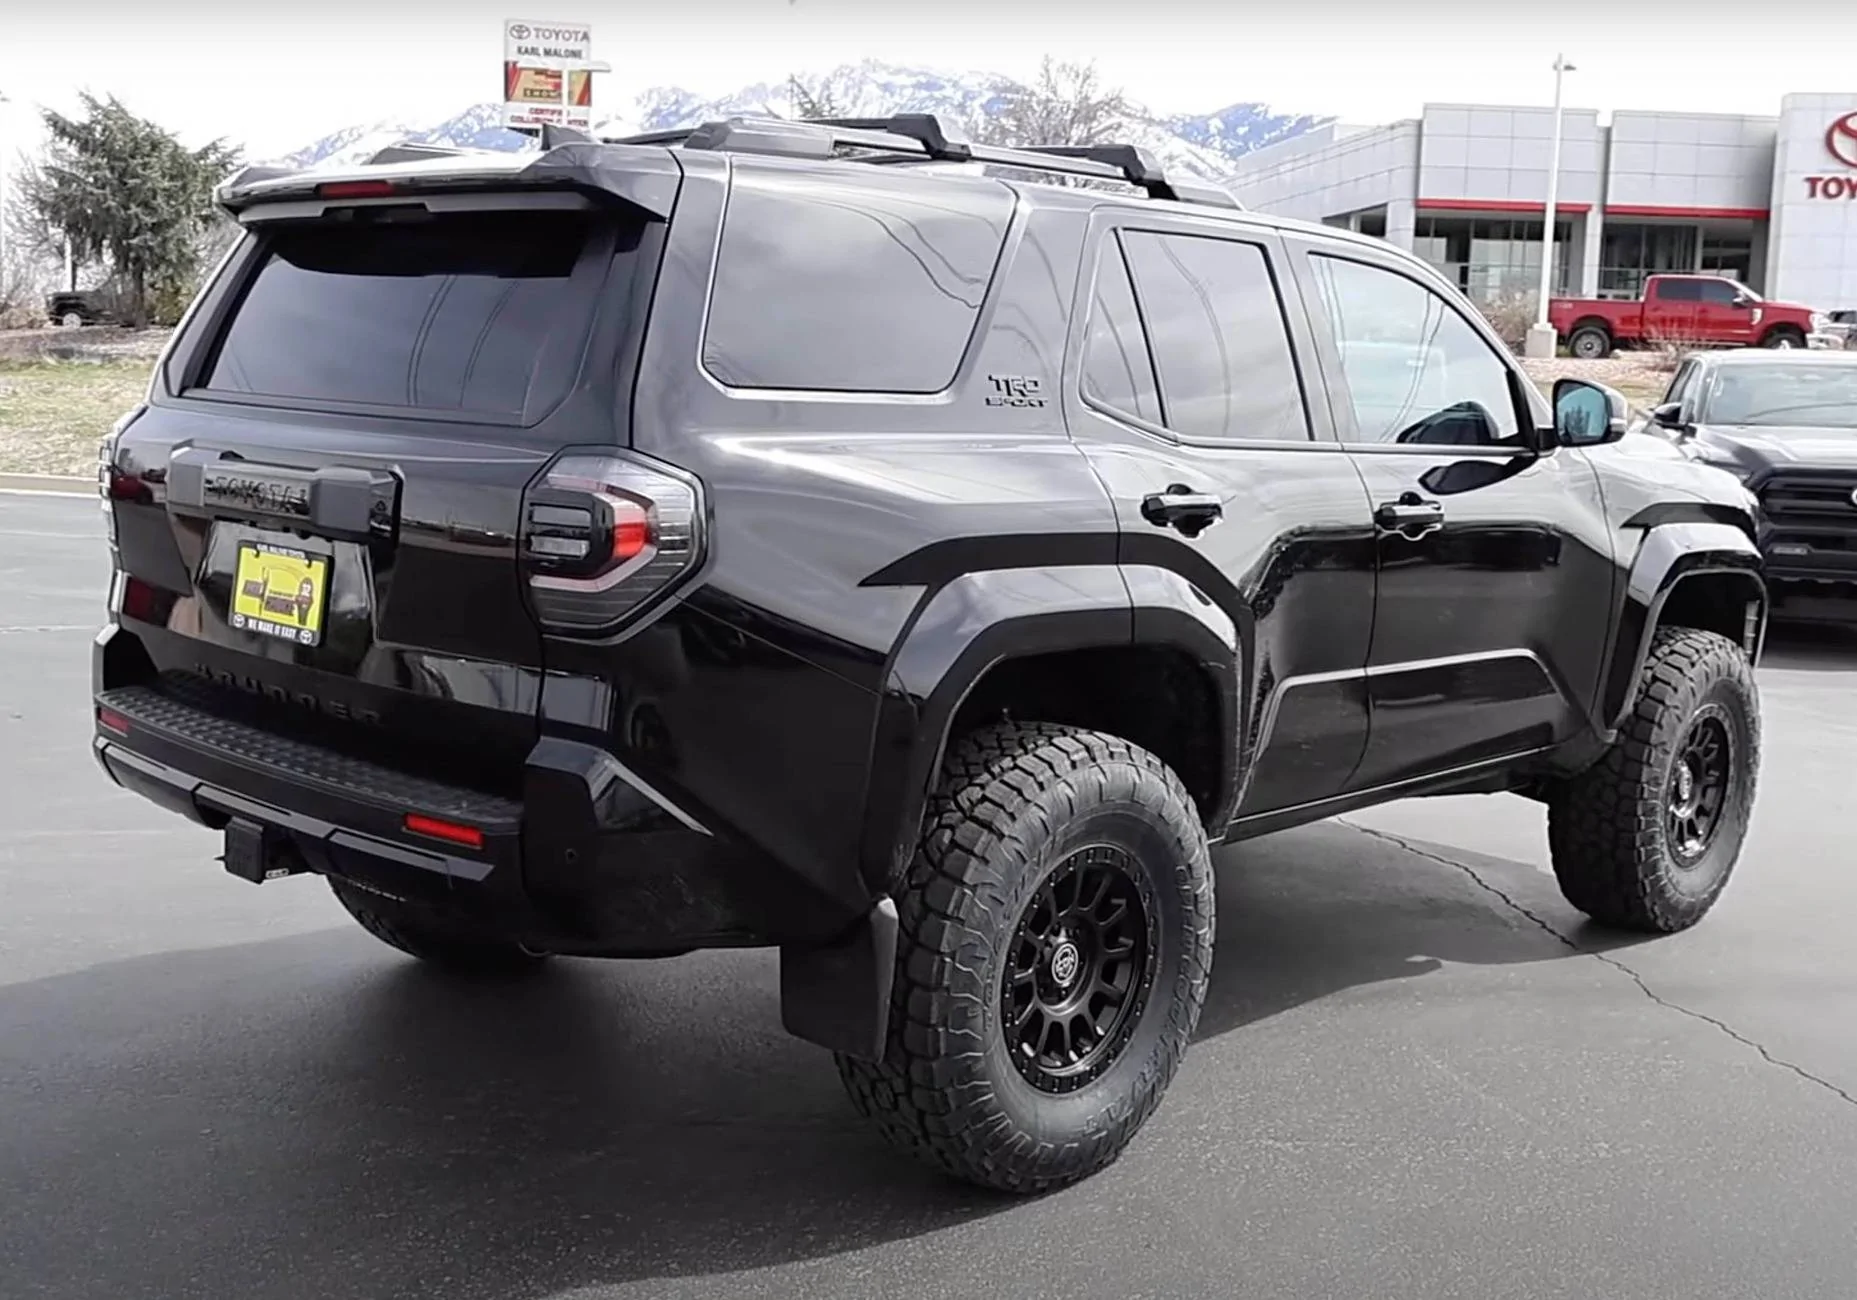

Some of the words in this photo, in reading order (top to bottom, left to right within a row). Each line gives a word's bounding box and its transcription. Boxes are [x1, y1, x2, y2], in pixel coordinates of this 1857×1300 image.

[533, 27, 590, 43] TOYOTA
[517, 45, 541, 57] KARL
[543, 47, 584, 60] MALONE
[987, 374, 1039, 397] TRD
[985, 397, 1049, 409] SPORT
[214, 476, 296, 513] TOYOTA
[247, 618, 258, 632] WE
[257, 620, 275, 636] MAKE
[281, 626, 297, 640] EASY
